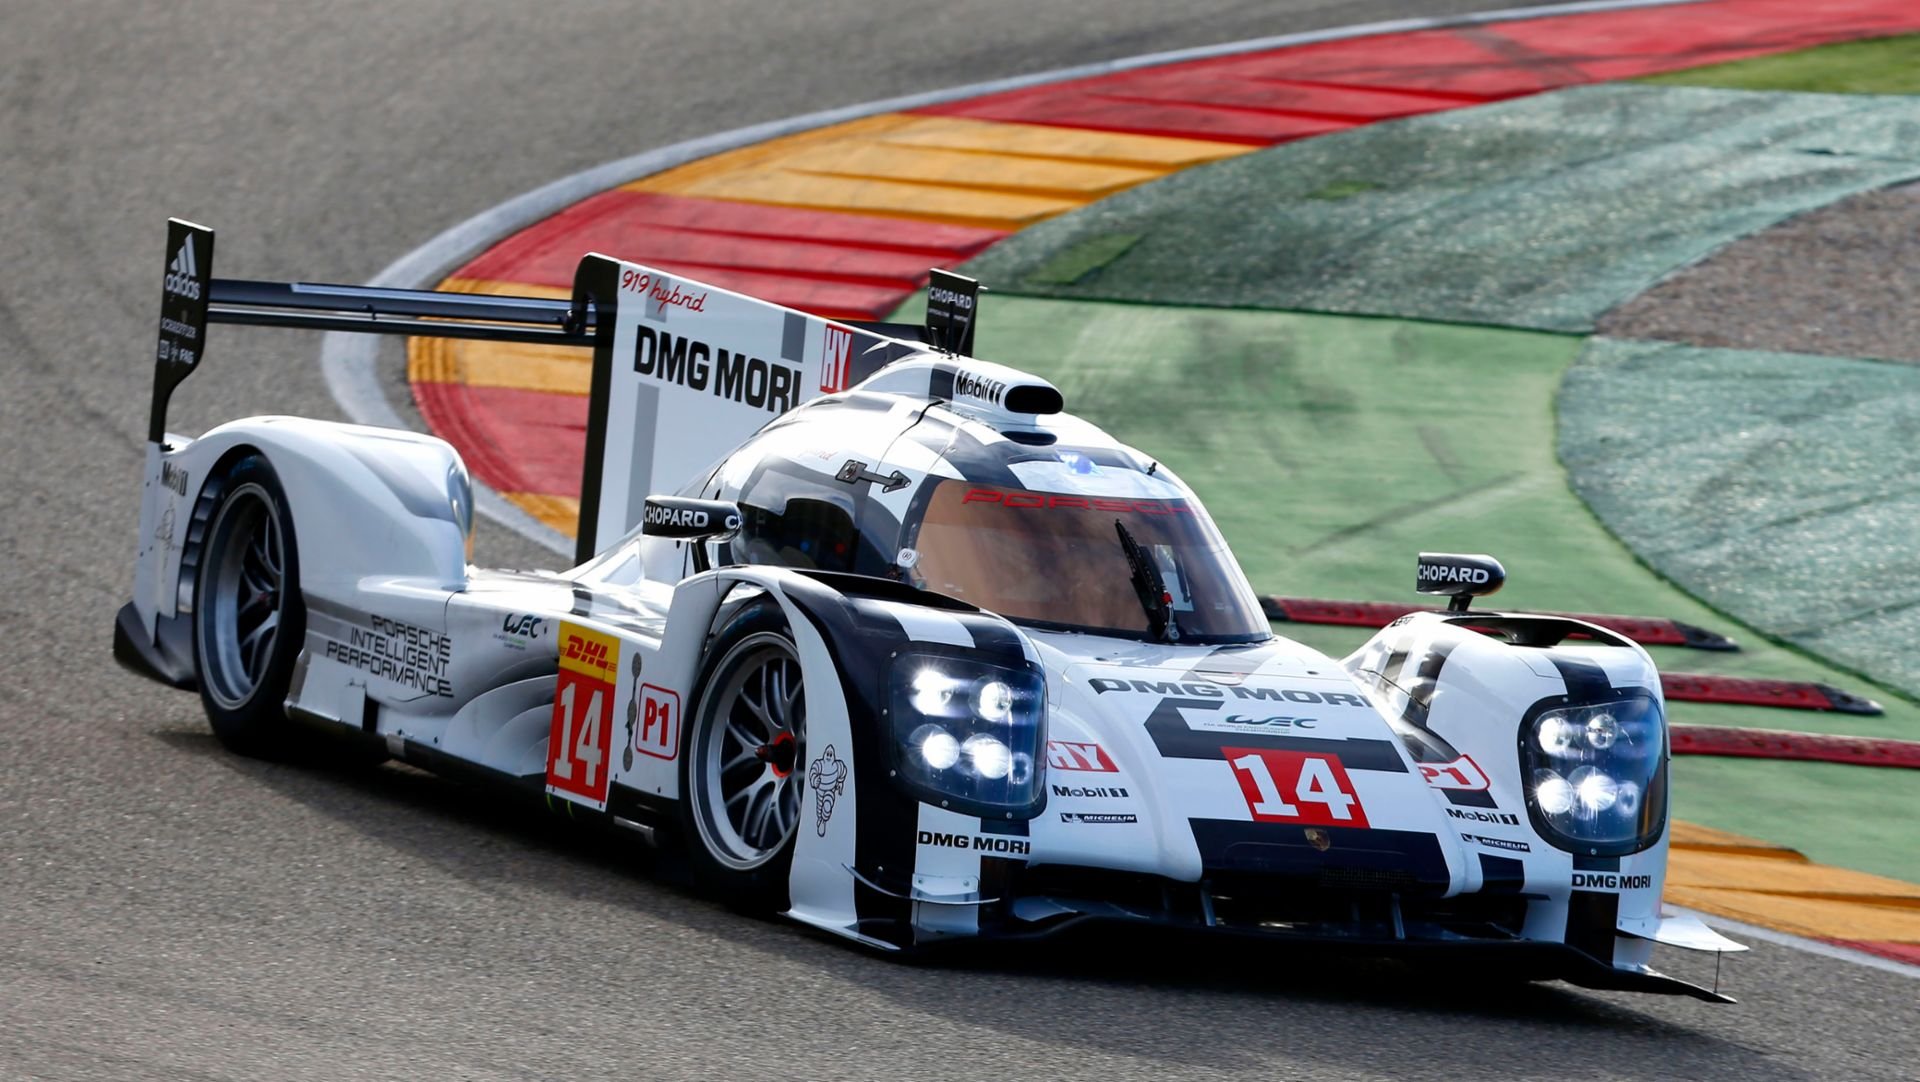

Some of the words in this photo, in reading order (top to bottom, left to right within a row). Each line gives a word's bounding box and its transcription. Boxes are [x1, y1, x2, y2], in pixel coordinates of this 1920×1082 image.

[165, 272, 200, 300] adidas
[621, 270, 650, 292] 919
[649, 278, 707, 314] hybrid
[929, 286, 972, 309] CHOPARD
[634, 324, 710, 391] DMG
[714, 348, 802, 414] MORI
[822, 327, 852, 391] HY
[956, 370, 992, 401] Mobil
[644, 505, 709, 528] CHOPARD
[1417, 564, 1489, 584] CHOPARD
[371, 614, 451, 657] PORSCHE
[503, 613, 543, 639] WEC
[350, 627, 450, 677] INTELLIGENT
[565, 635, 609, 669] DHL
[326, 641, 454, 698] PERFORMANCE
[1088, 678, 1224, 698] DMG
[1227, 686, 1373, 708] MORI
[553, 682, 604, 788] 14
[642, 697, 670, 747] P1
[1226, 714, 1318, 729] WEC
[1047, 741, 1105, 770] HY
[1233, 753, 1356, 820] 14
[1417, 766, 1472, 786] P1
[1052, 784, 1108, 798] Mobil
[1445, 807, 1501, 824] Mobil
[918, 831, 970, 849] DMG
[973, 836, 1031, 855] MORI
[1481, 837, 1529, 850] MICHELIN
[1571, 873, 1617, 889] DMG
[1619, 874, 1651, 889] MORI
